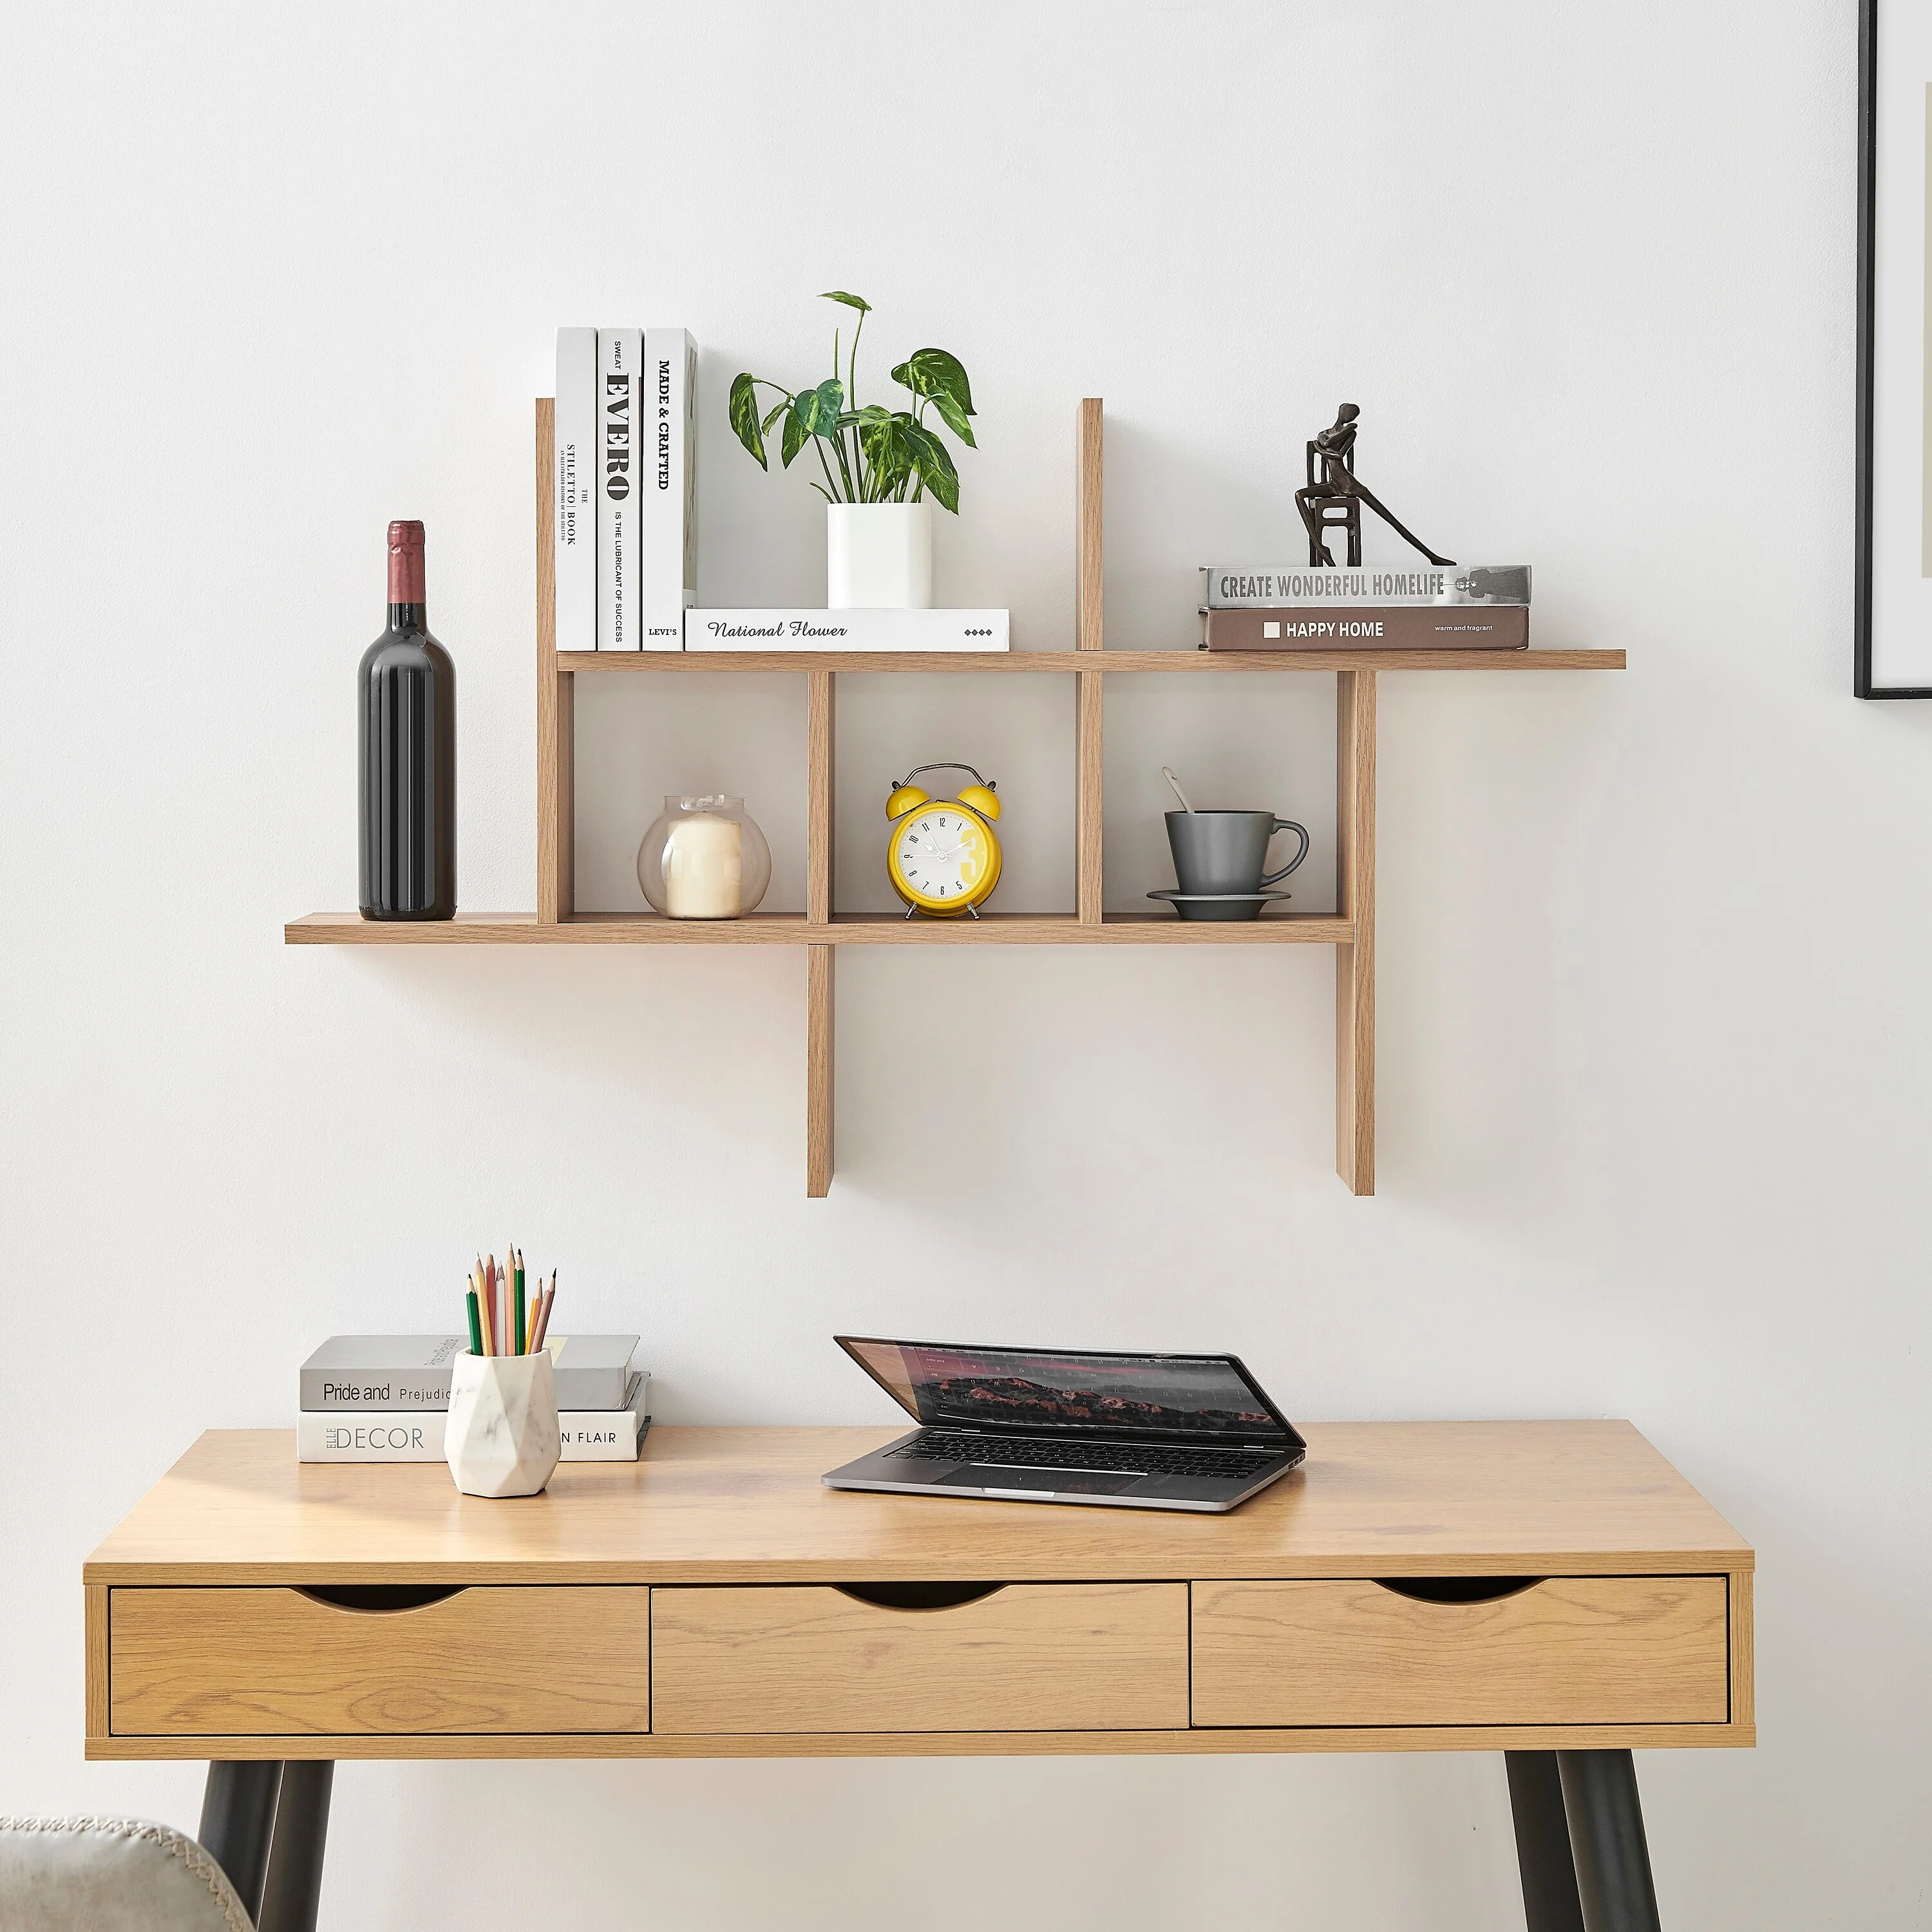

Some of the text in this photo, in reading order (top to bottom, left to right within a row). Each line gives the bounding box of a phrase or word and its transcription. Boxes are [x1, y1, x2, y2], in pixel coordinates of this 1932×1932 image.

[658, 360, 669, 489] MADE & CRAFTED
[606, 372, 629, 500] EVERO
[567, 512, 575, 545] BOOK
[1220, 573, 1444, 598] CREATE WONDERFUL HOMELIFE
[615, 589, 621, 600] OF
[707, 621, 848, 638] National Flower
[1287, 621, 1383, 638] HAPPY HOME
[922, 822, 930, 832] 11
[939, 817, 945, 827] 12
[908, 835, 919, 844] 10
[922, 881, 929, 890] 7
[940, 886, 945, 896] 6
[955, 880, 963, 890] 5
[324, 1383, 451, 1403] Pride and Prejudic
[326, 1428, 336, 1449] ELLE
[336, 1428, 424, 1449] DECOR
[578, 1432, 616, 1443] FLAIR
